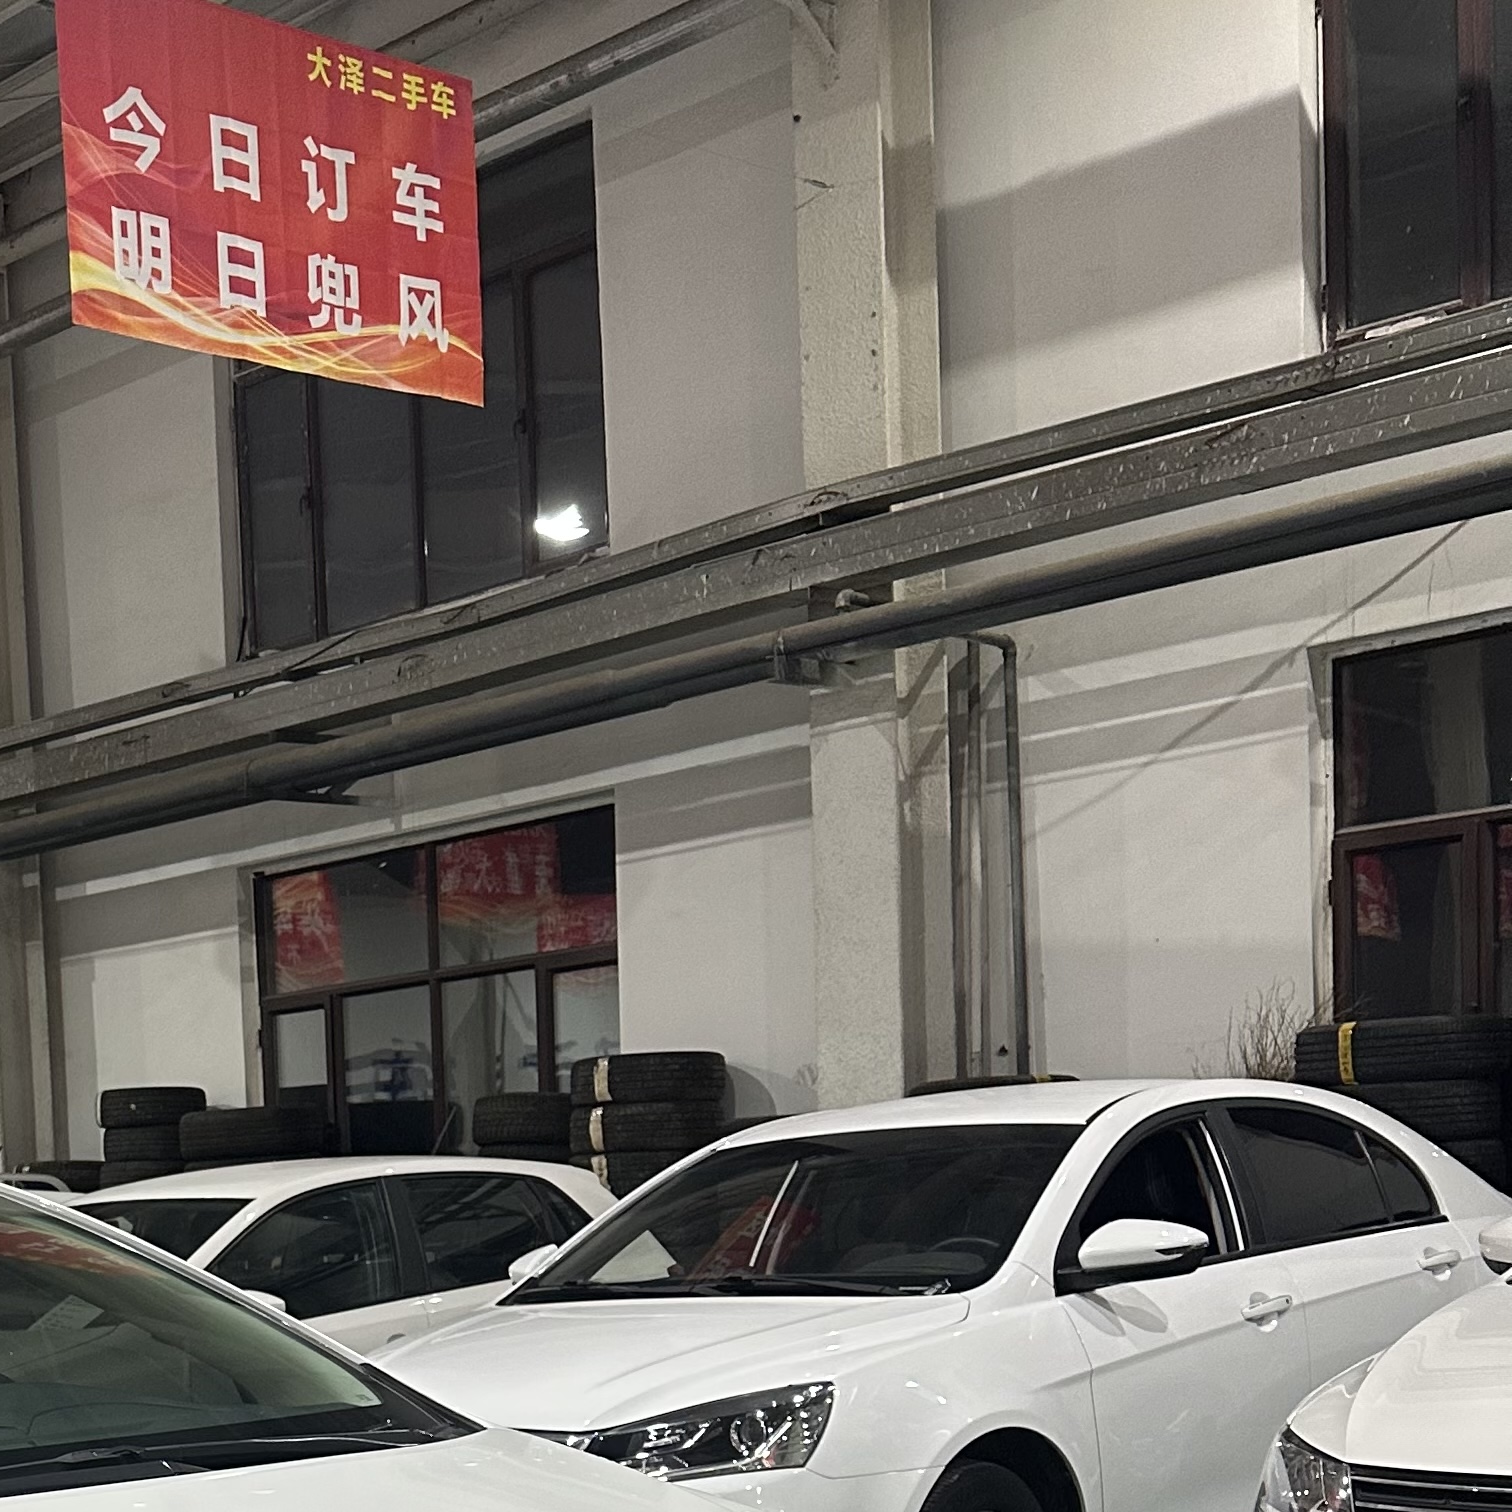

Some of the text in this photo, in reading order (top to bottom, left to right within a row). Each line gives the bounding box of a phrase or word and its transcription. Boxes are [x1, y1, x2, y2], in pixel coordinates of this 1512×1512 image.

[307, 46, 457, 120] 大泽二手车
[102, 86, 445, 242] 今日订车
[111, 205, 450, 353] 明日兜风
